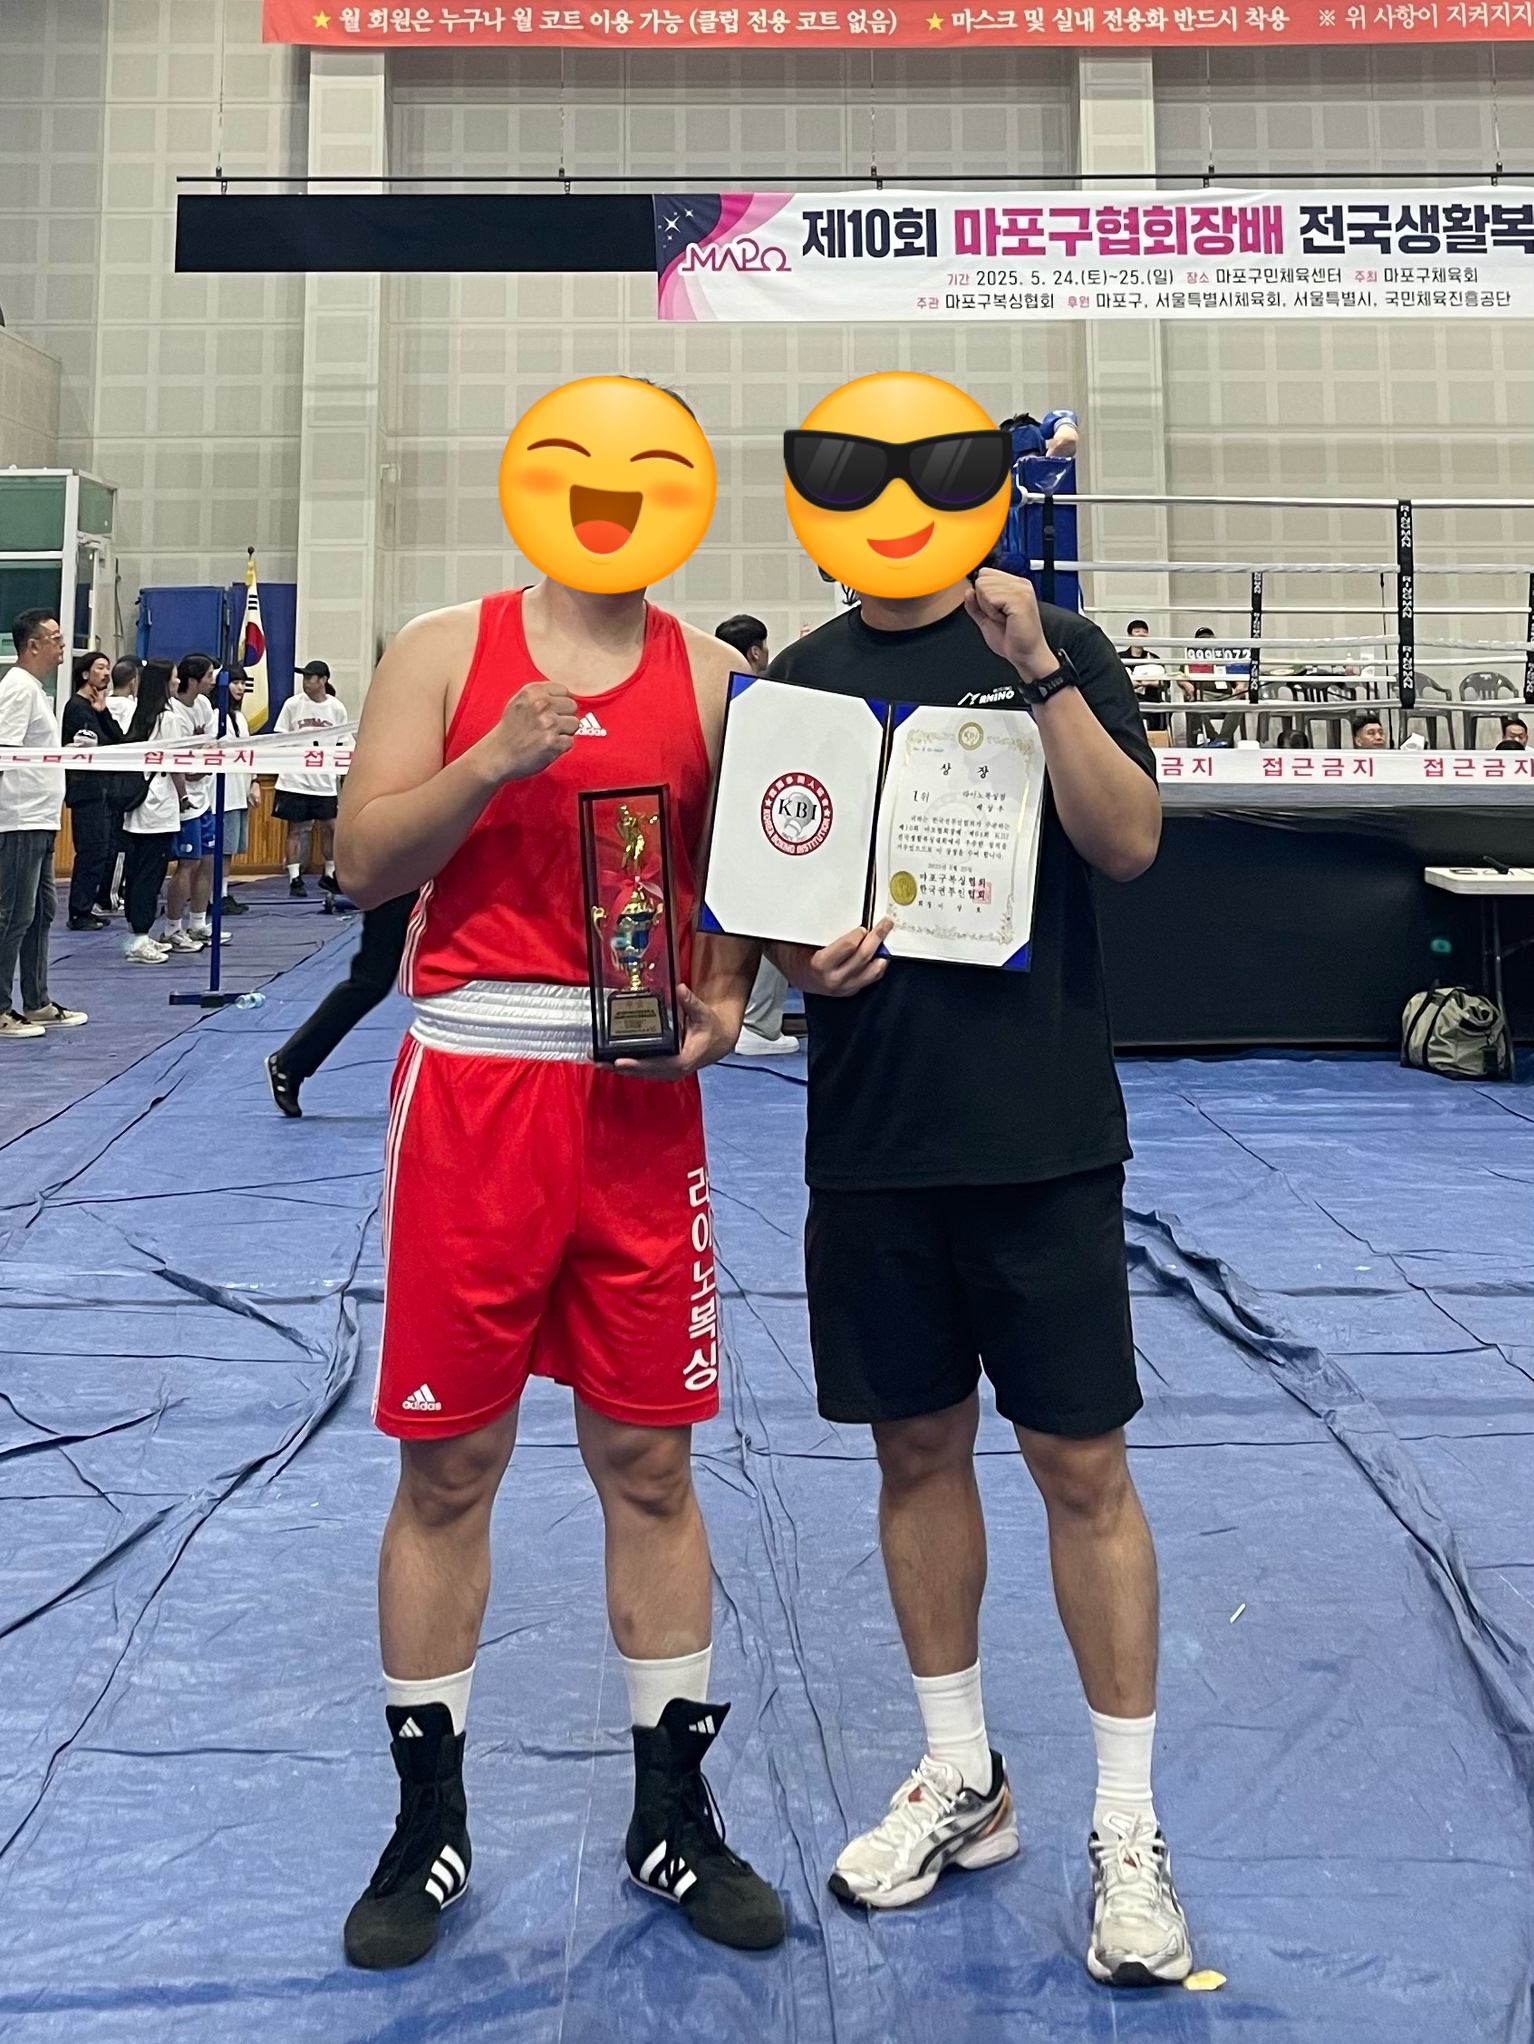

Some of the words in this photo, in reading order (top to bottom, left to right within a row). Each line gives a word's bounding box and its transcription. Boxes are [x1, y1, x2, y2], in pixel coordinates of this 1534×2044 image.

[339, 7, 361, 33] 월
[367, 7, 435, 33] 회원은
[439, 7, 506, 33] 누구나
[511, 7, 533, 33] 월
[539, 10, 584, 31] 코트
[590, 9, 634, 34] 이용
[639, 10, 684, 34] 가능
[690, 9, 739, 34] (클럽
[746, 9, 790, 34] 전용
[795, 11, 840, 31] 코트
[847, 9, 897, 35] 없음)
[951, 8, 1018, 33] 마스크
[1024, 8, 1045, 32] 및
[1052, 7, 1094, 33] 실내
[1102, 7, 1169, 33] 전용화
[1173, 7, 1238, 33] 반드시
[1245, 6, 1290, 31] 착용
[1345, 5, 1366, 30] 위
[1373, 4, 1438, 29] 사항이
[1446, 2, 1533, 28] 지켜지지
[802, 207, 938, 259] 제10회
[954, 205, 1284, 257] 마포구협회장배
[1299, 203, 1534, 255] 전국생활복
[682, 238, 792, 271] MAPO
[947, 273, 970, 286] 기간
[976, 271, 1023, 287] 2025.
[1186, 271, 1209, 284] 장소
[1216, 267, 1342, 284] 마포구민체육센터
[1355, 270, 1378, 283] 주최
[1384, 267, 1478, 283] 마포구체육회
[917, 297, 940, 310] 주관
[945, 293, 1054, 310] 마포구복싱협회
[1067, 296, 1090, 309] 후원
[1096, 292, 1148, 310] 마포구,
[1155, 291, 1286, 309] 서울특별시체육회,
[1293, 291, 1377, 308] 서울특별시,
[1385, 290, 1511, 308] 국민체육진흥공단
[1400, 505, 1411, 548] RINGMAN
[1402, 575, 1413, 618] RINGMAN
[1403, 645, 1413, 689] RINGMAN
[575, 728, 607, 737] didas
[1262, 757, 1374, 778] 접근금지
[1423, 757, 1534, 779] 접근금지
[778, 799, 817, 820] KBI
[402, 1401, 442, 1411] adidas
